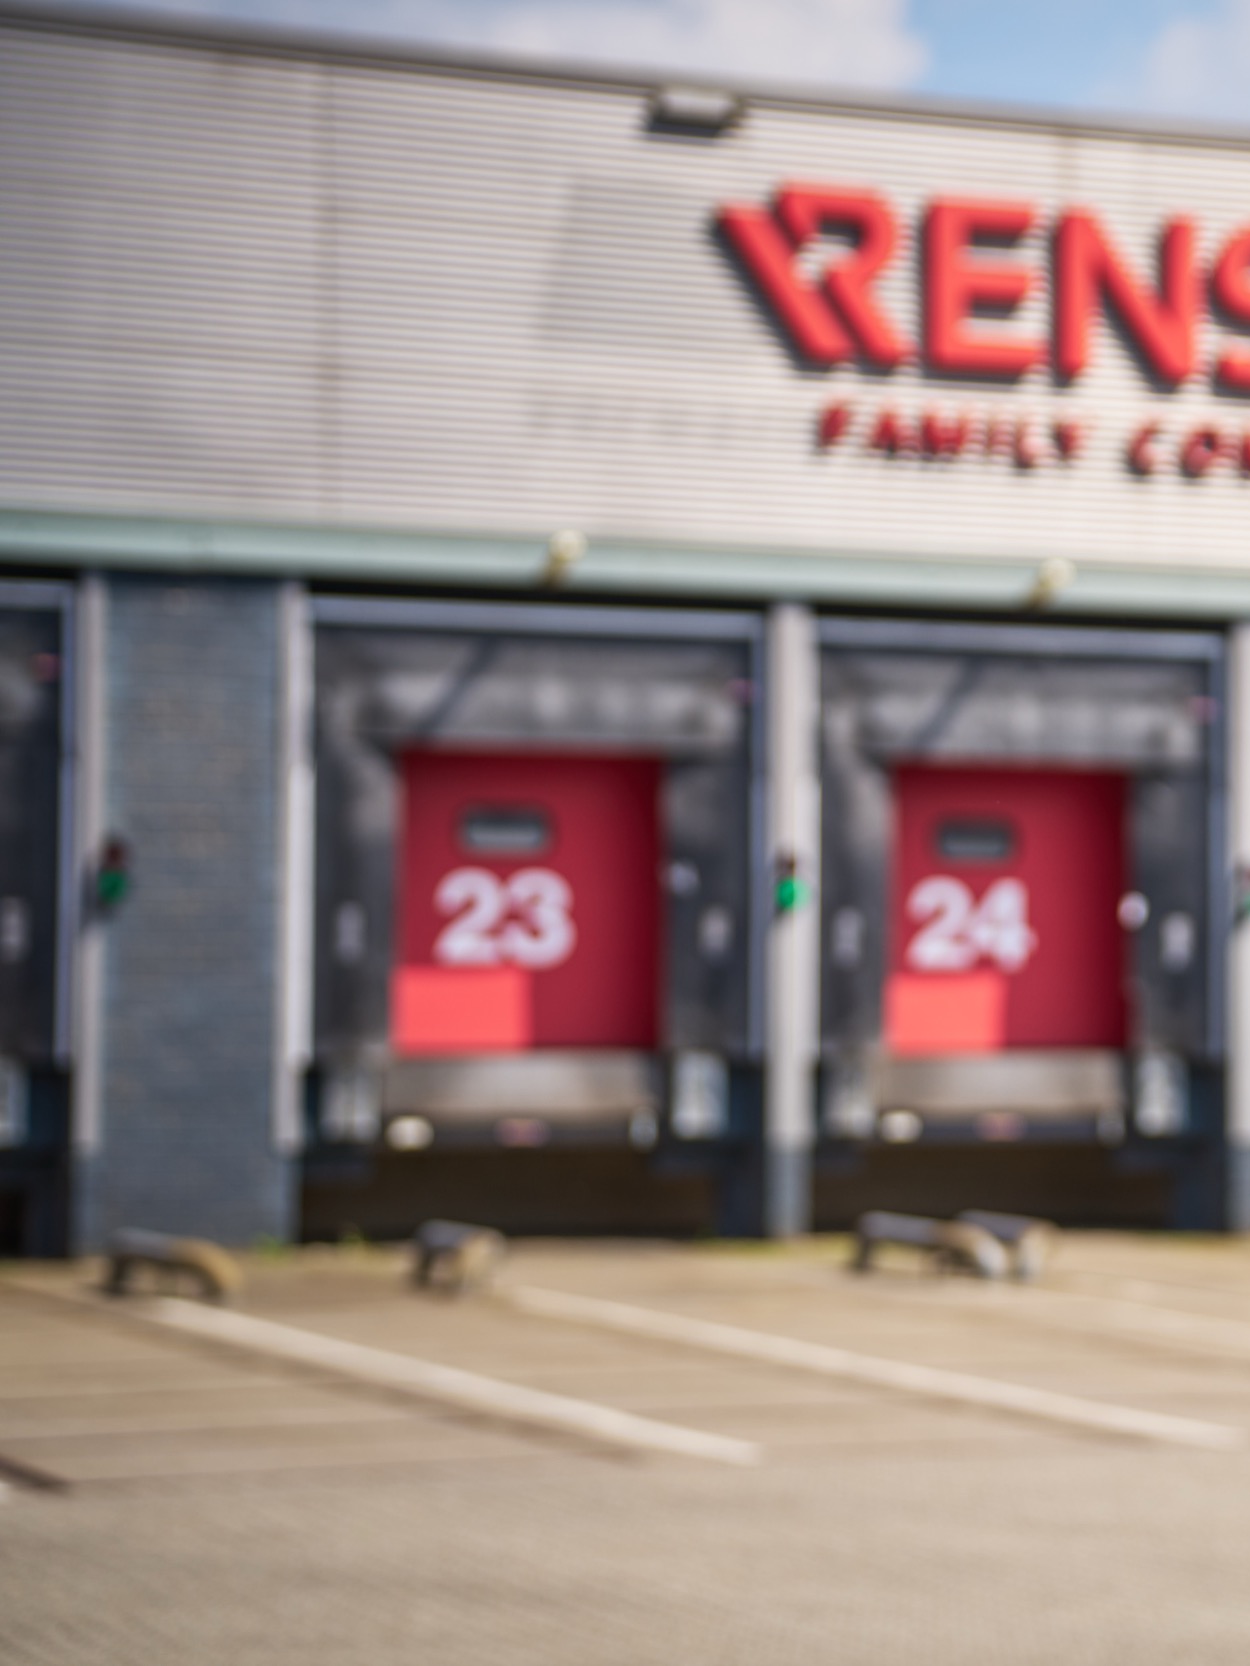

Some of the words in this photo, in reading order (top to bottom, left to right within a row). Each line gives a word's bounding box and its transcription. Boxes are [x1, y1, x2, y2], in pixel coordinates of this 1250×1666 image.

[817, 402, 1084, 465] FAMILY
[435, 867, 574, 968] 23
[907, 876, 1036, 974] 24
